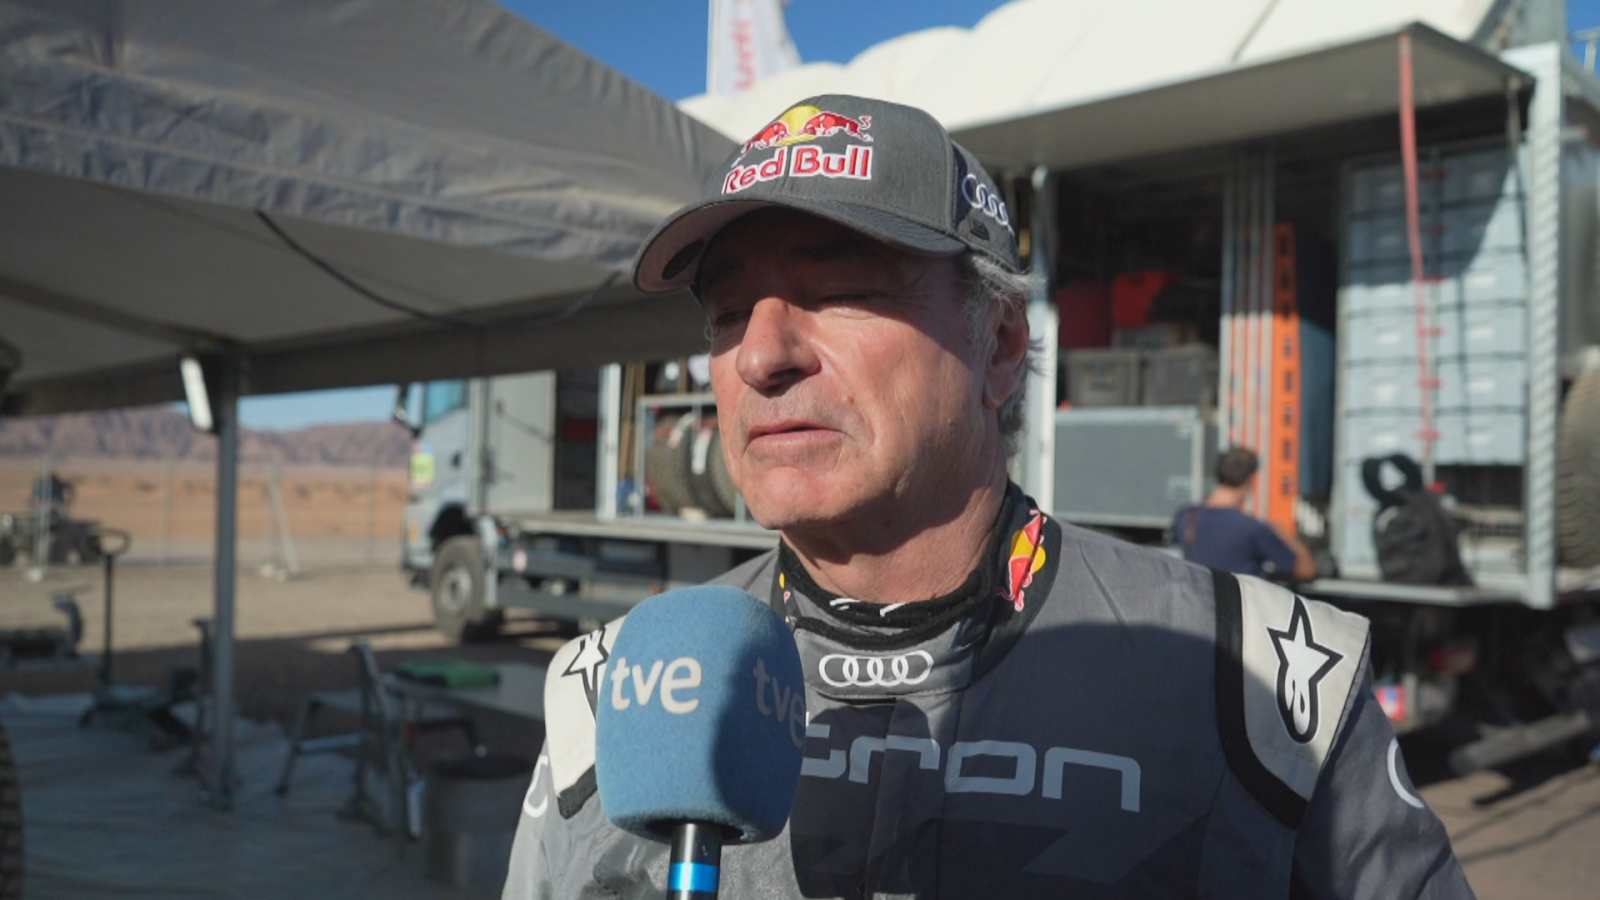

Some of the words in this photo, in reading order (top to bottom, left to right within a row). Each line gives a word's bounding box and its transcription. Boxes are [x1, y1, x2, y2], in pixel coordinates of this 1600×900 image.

[723, 147, 786, 193] Red
[792, 146, 871, 178] Bull
[610, 656, 702, 714] tve
[753, 657, 806, 749] tve
